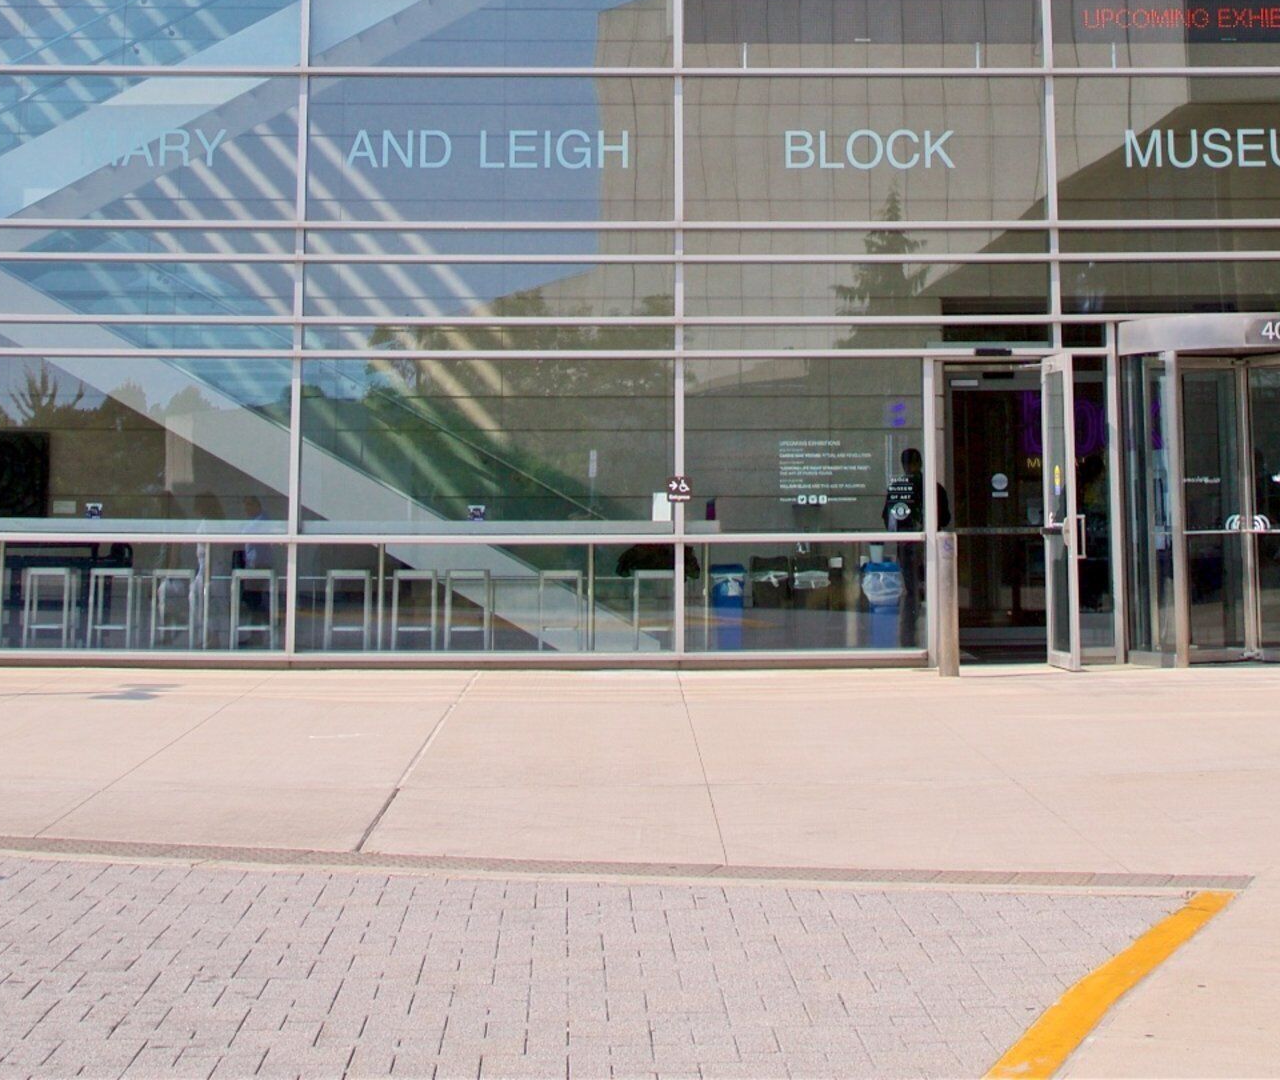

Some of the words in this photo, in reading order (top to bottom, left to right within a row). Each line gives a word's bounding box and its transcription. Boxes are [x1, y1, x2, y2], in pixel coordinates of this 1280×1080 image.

[1083, 8, 1209, 29] UPCOMING
[346, 129, 452, 168] AND
[479, 129, 629, 169] LEIGH
[784, 129, 955, 169] BLOCK
